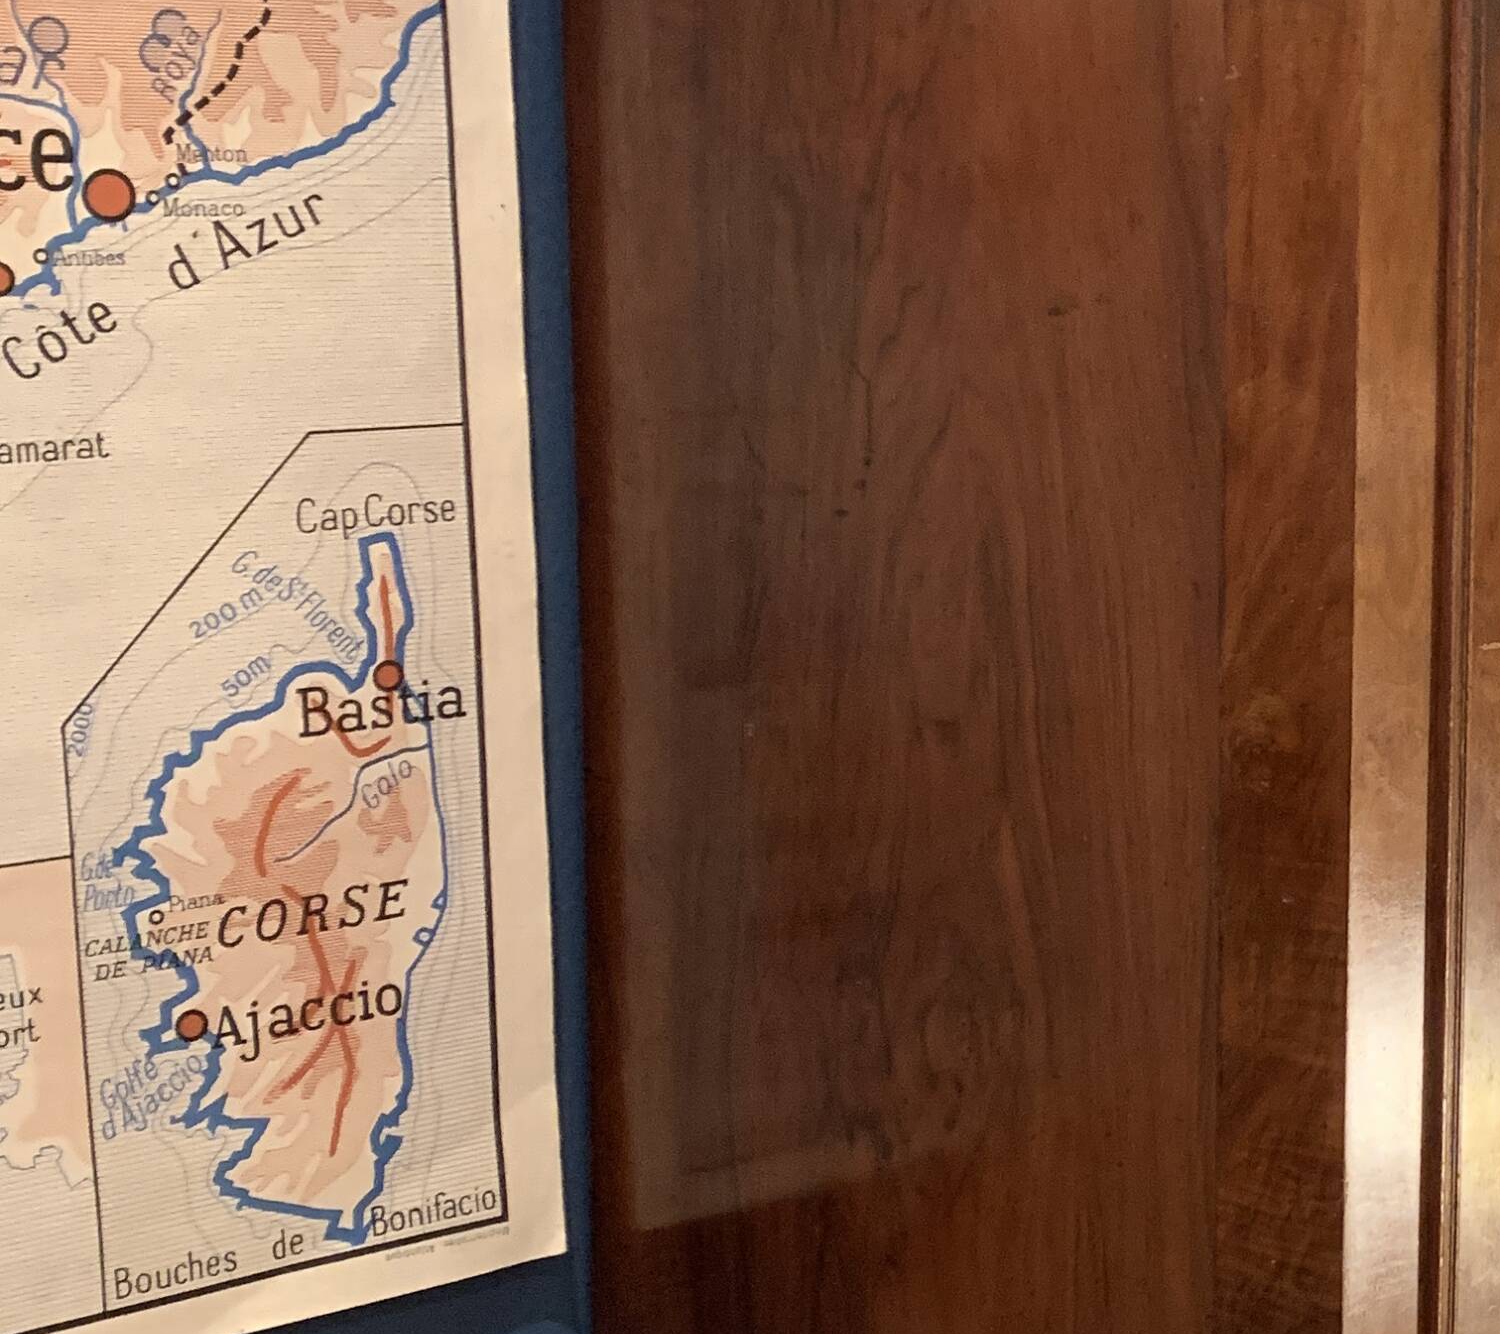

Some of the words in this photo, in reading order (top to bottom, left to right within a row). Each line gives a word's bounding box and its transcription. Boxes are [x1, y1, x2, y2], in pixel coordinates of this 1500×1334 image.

[175, 142, 248, 163] Menton
[163, 197, 247, 217] Monaco
[1, 302, 117, 379] Côte
[167, 192, 325, 291] d'Azur
[296, 497, 358, 540] Cap
[364, 493, 456, 528] Corse
[294, 591, 365, 661] Florent
[295, 679, 467, 738] Bastia
[217, 879, 409, 950] CORSE
[94, 960, 127, 982] DE
[213, 981, 403, 1062] Ajaccio
[113, 1248, 238, 1301] Bouches
[272, 1228, 305, 1261] de
[371, 1184, 498, 1238] Bonifacio
